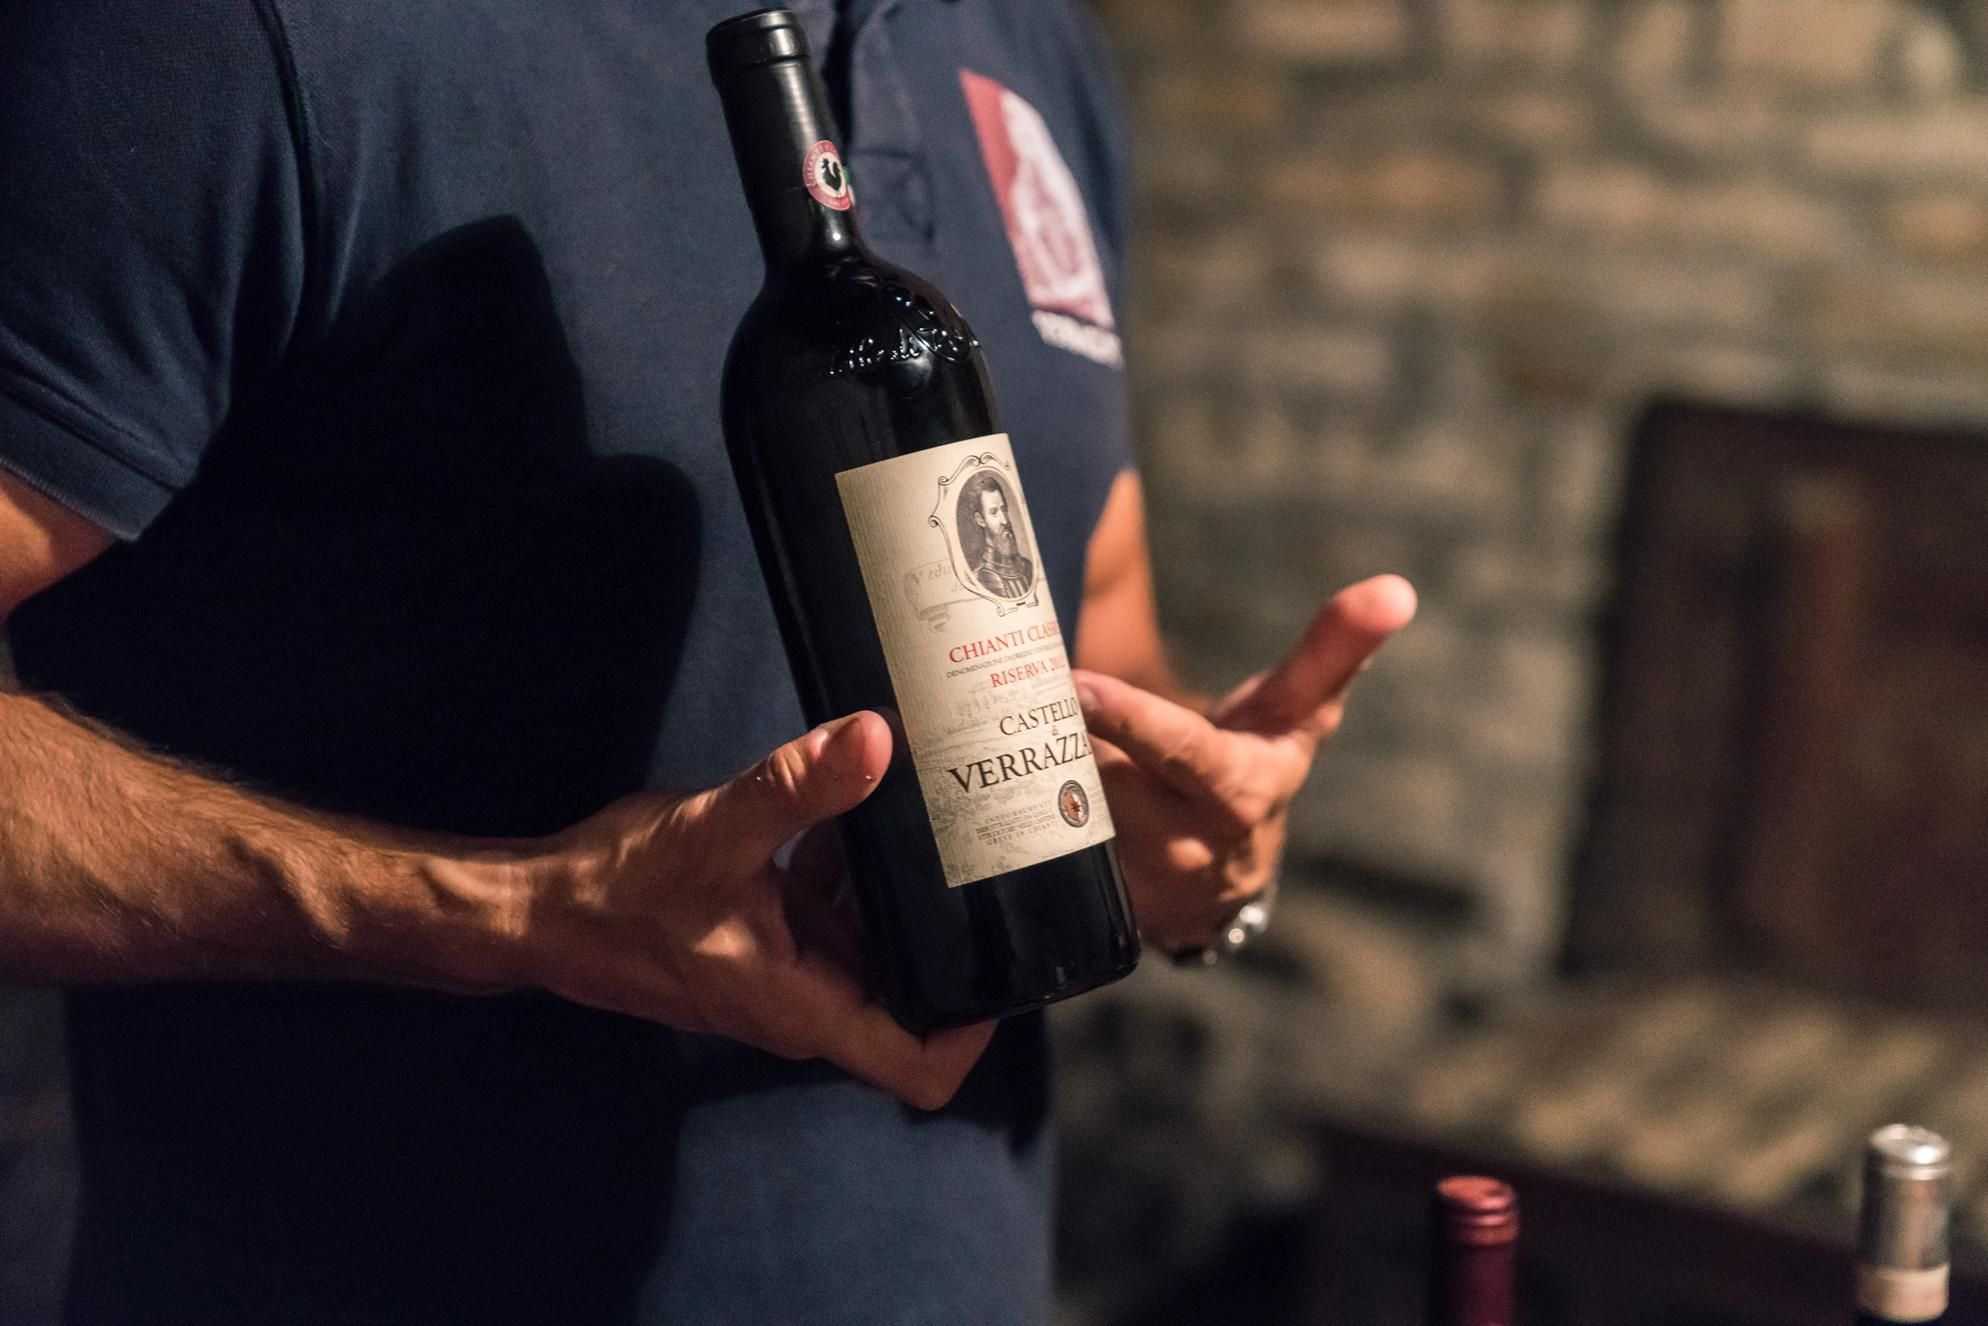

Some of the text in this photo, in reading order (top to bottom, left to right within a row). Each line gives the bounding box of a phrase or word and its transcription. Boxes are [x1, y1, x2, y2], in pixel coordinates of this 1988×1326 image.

[948, 629, 1025, 663] CHIANTI
[990, 660, 1048, 688] RISERVA
[999, 697, 1078, 736] CASTELLO
